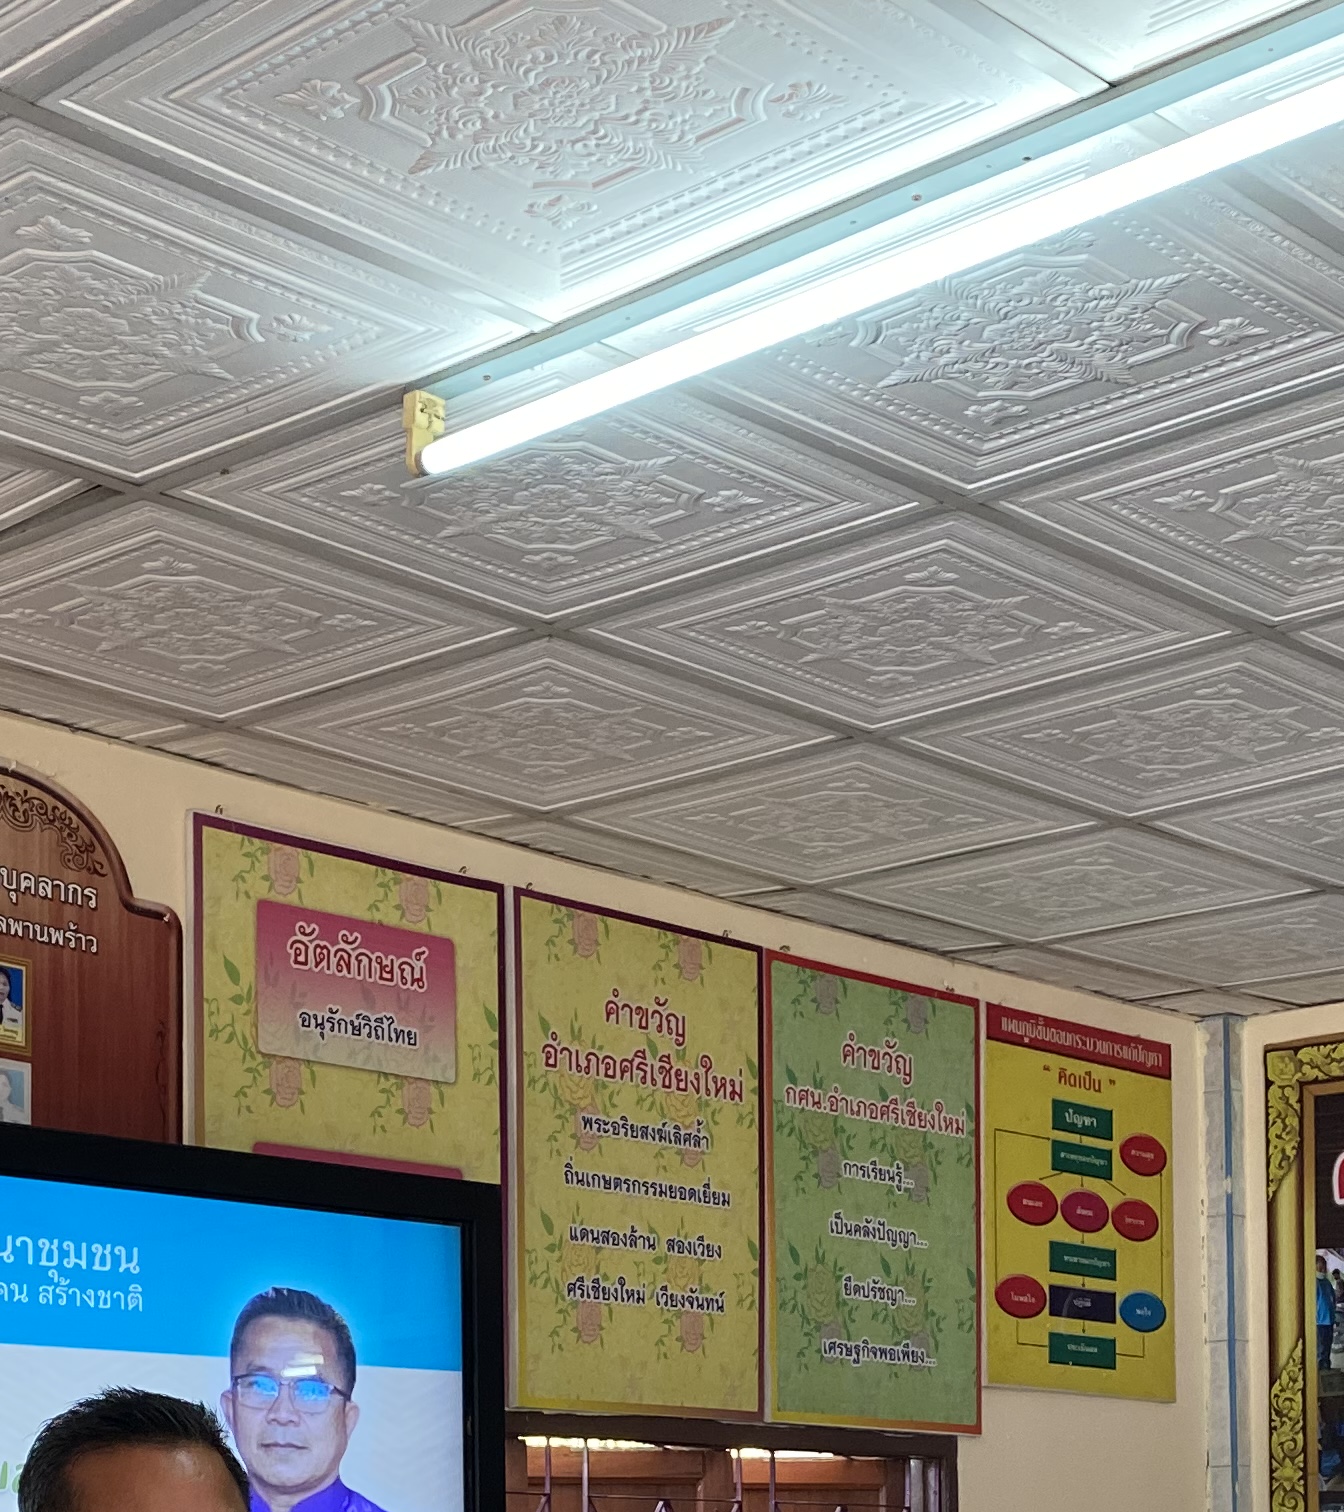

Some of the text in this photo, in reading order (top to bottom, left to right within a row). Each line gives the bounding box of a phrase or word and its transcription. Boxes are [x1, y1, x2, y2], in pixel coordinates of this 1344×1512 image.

[288, 923, 428, 991] อัตลักษณ์
[299, 1006, 419, 1047] อนุรักษ์วิถีไทย
[605, 988, 686, 1046] คำขวัญ
[541, 1031, 744, 1102] อำเภอศรีเชียงใหม่
[841, 1032, 913, 1086] คำขวัญ
[1057, 1067, 1102, 1093] คิดเป็น
[785, 1086, 967, 1137] กศน.อำเภอศรีเชียงใหม่
[1064, 1108, 1097, 1128] ปัญหา
[581, 1115, 711, 1150] พระอริยสงฆ์เลิศล้ำ
[563, 1156, 732, 1207] ถิ่นเกษตรกรรมยอดเยี่ยม
[569, 1225, 723, 1260] แดนสองล้าน สองเวียง
[38, 1276, 144, 1312] สร้างชาติ
[566, 1275, 726, 1313] ศรีเชียงใหม่ เวียงจันทน์
